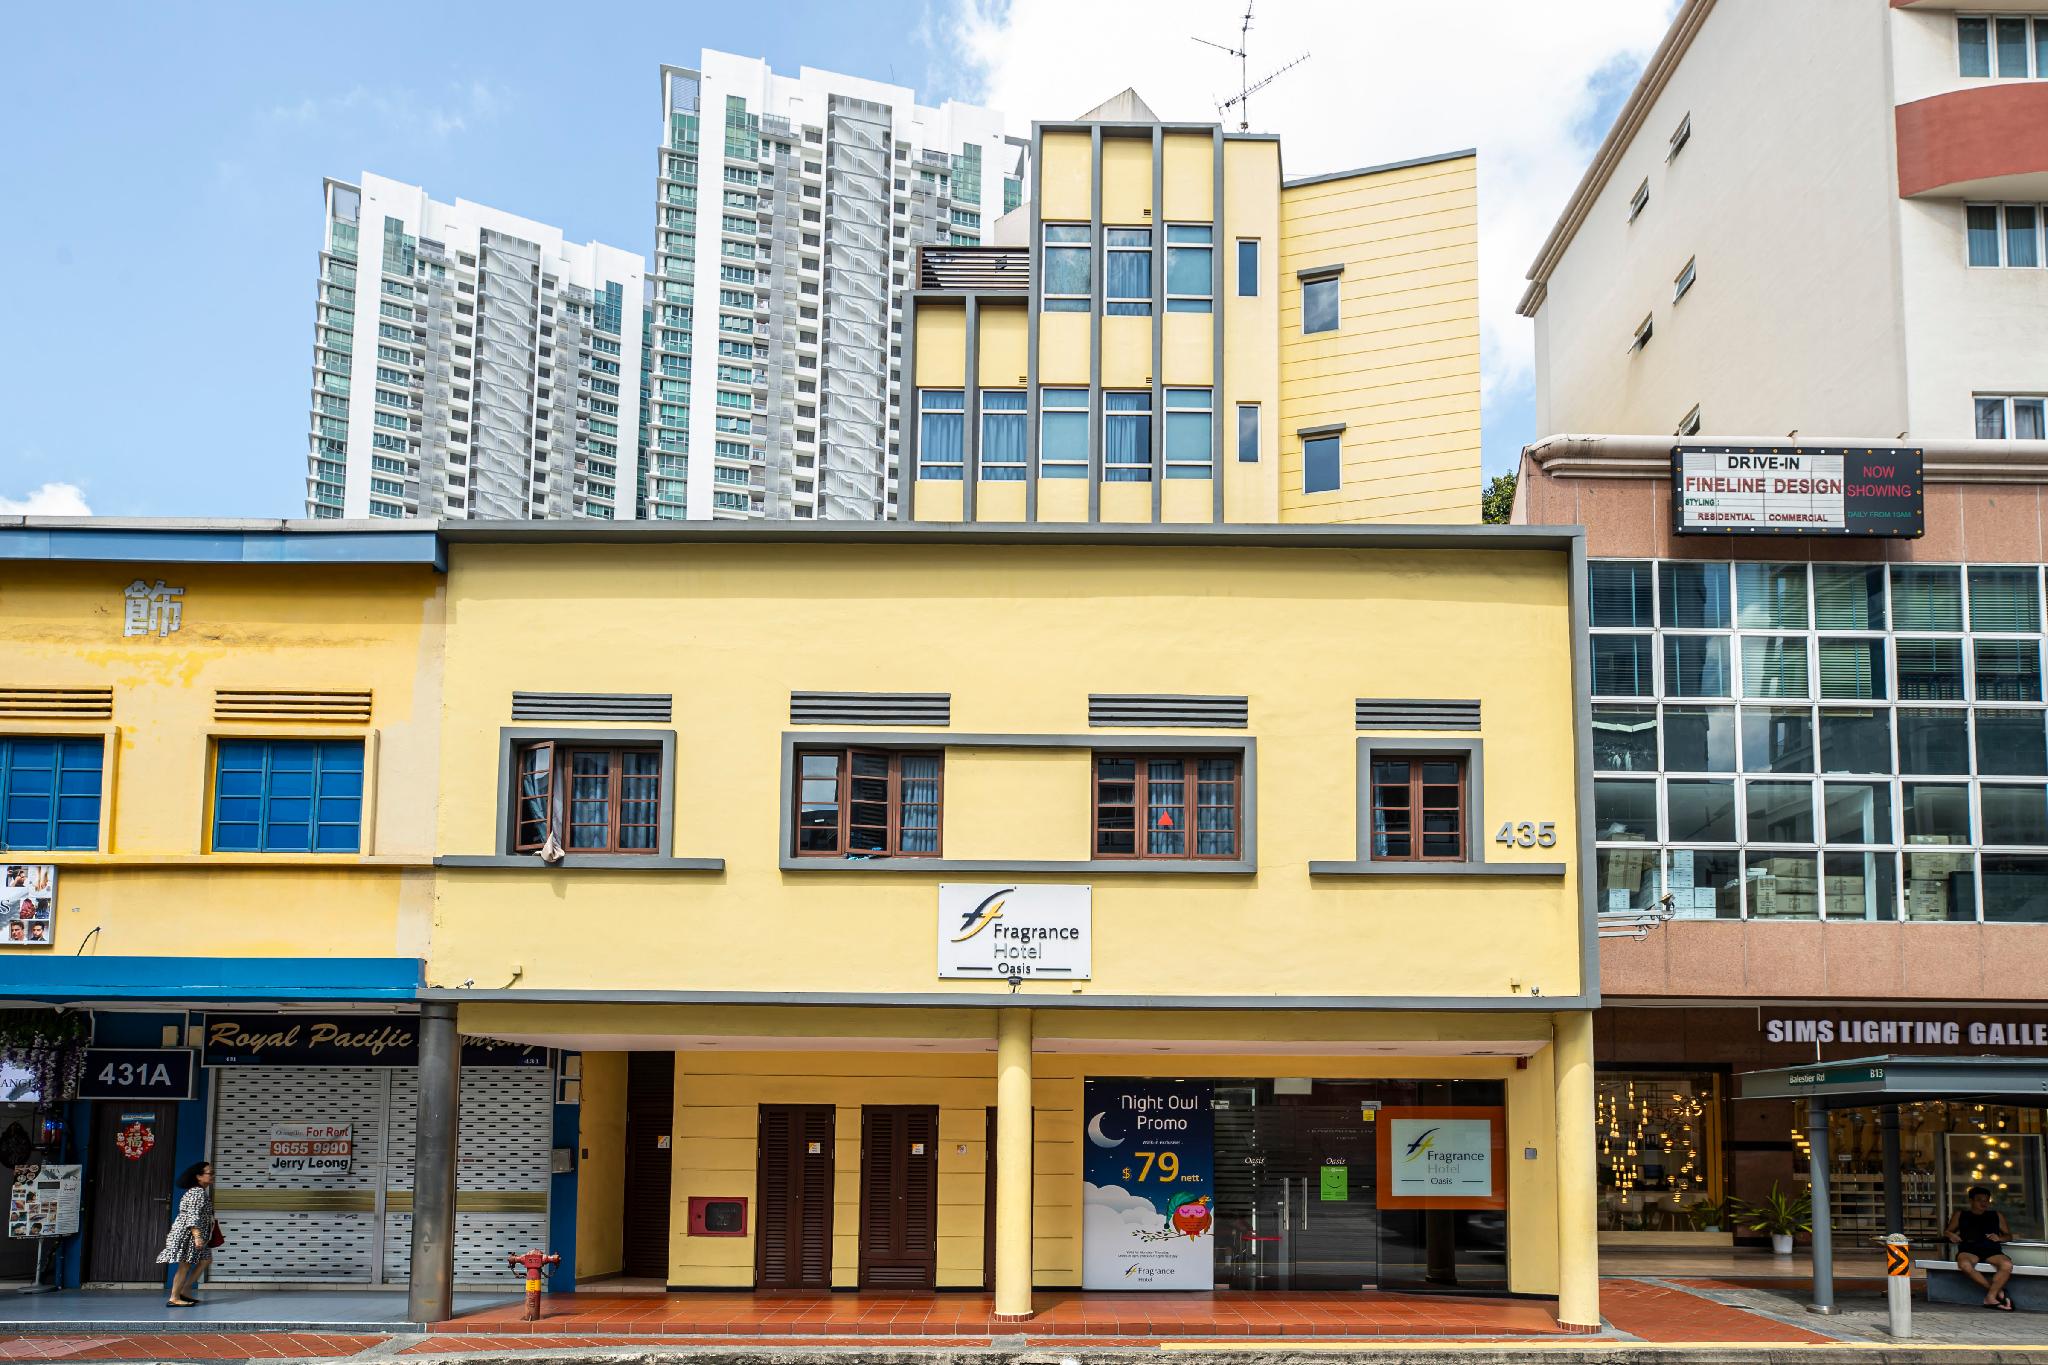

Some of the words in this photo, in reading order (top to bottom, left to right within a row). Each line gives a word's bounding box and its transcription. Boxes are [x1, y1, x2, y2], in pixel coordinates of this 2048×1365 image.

[1728, 456, 1800, 470] DRIVE-IN
[1863, 465, 1895, 478] NOW
[1686, 476, 1766, 493] FINELINE
[1774, 478, 1842, 494] DESIGN
[1847, 484, 1912, 497] SHOWING
[1698, 512, 1755, 521] RESIDENTIAL
[1768, 513, 1828, 522] COMMERCIAL
[123, 580, 184, 637] 飾
[1496, 821, 1557, 849] 435
[993, 923, 1080, 943] Fragrance
[993, 943, 1042, 959] Hotel
[997, 962, 1031, 974] Oasis
[209, 1022, 300, 1054] Royal
[309, 1023, 414, 1056] Pacific
[1767, 1020, 1834, 1043] SIMS
[1839, 1020, 1960, 1044] LIGHTING
[1968, 1022, 2048, 1046] GALLE
[98, 1063, 171, 1086] 431A
[1789, 1075, 1815, 1083] Balestier
[1816, 1073, 1825, 1081] Rd
[1870, 1068, 1884, 1078] B13
[1121, 1095, 1164, 1112] Night
[1168, 1095, 1198, 1109] Owl
[1137, 1115, 1188, 1130] Promo
[306, 1126, 323, 1137] For
[326, 1126, 349, 1137] Rent
[273, 1142, 308, 1154] 9655
[313, 1142, 348, 1154] 9990
[272, 1157, 305, 1170] Jerry
[308, 1157, 348, 1170] Leong
[1326, 1156, 1346, 1165] Oasis
[1427, 1150, 1485, 1164] Fragrance
[1427, 1163, 1460, 1174] Hotel
[1430, 1177, 1453, 1185] Oasis
[1138, 1267, 1175, 1276] Fragrance
